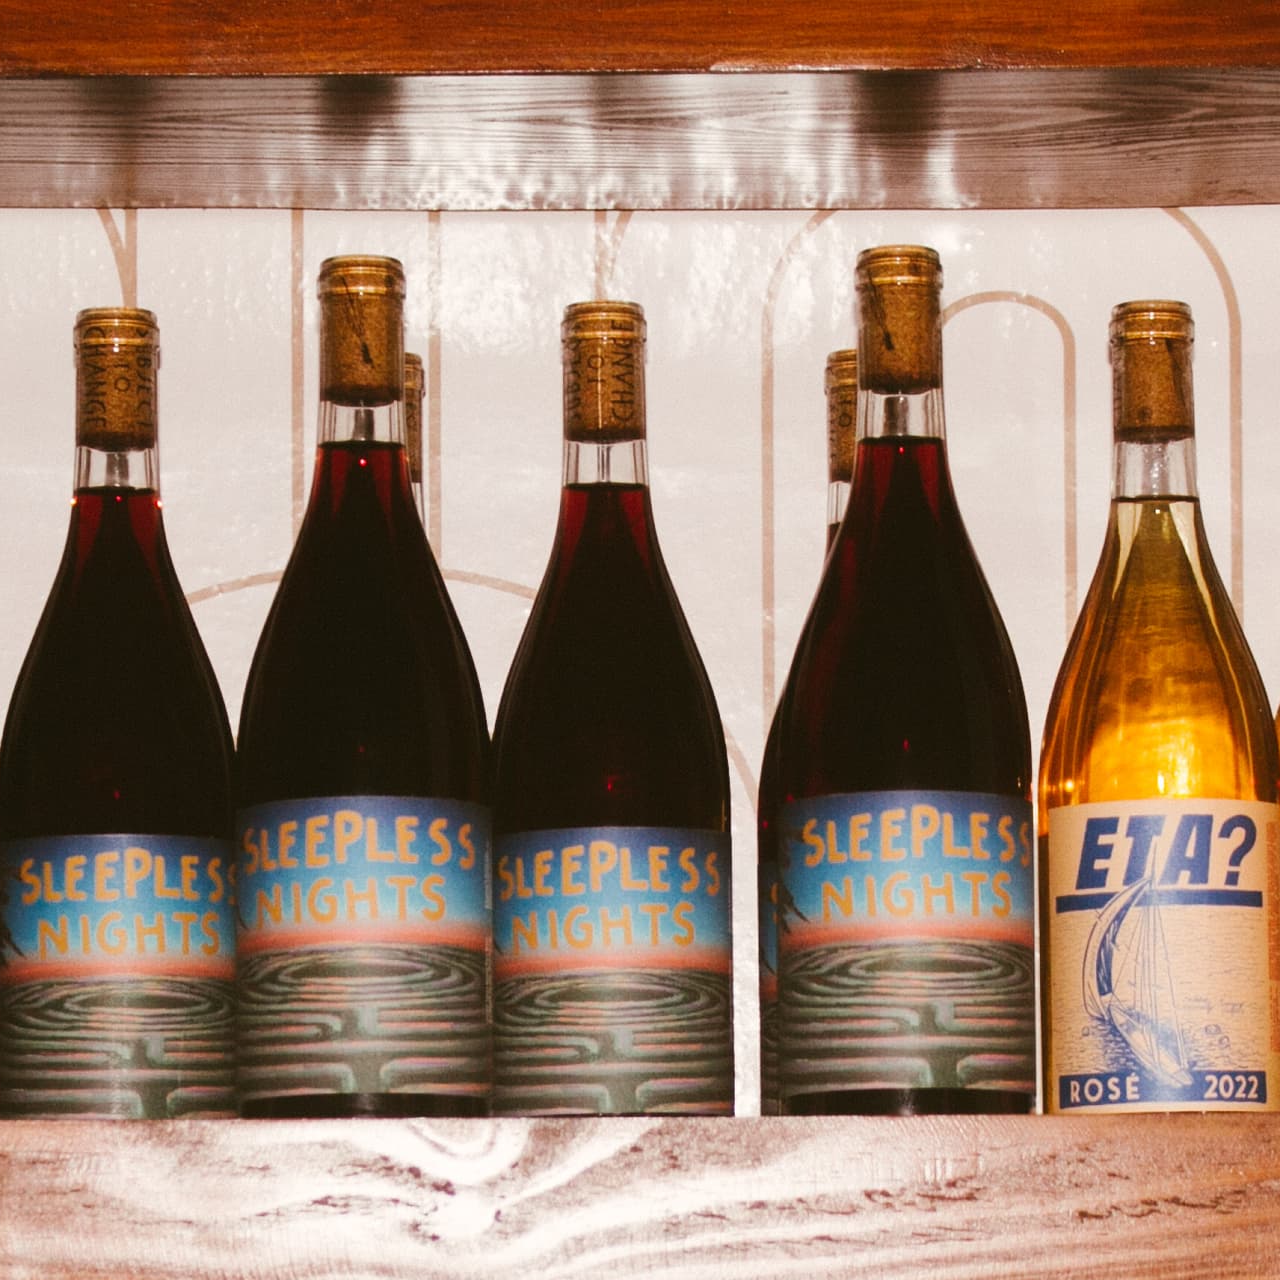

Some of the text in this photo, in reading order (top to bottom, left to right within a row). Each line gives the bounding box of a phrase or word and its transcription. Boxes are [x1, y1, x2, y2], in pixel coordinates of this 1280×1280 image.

[243, 810, 476, 874] SLEEPLESS
[801, 804, 1031, 868] SLEEPLESS
[1076, 814, 1258, 889] ETA?
[498, 840, 720, 901] SLEEPLESS
[821, 871, 1013, 923] NIGHTS
[255, 873, 447, 930] NIGHTS
[511, 900, 696, 957] NIGHTS
[38, 910, 221, 961] NIGHTS
[1070, 1072, 1260, 1104] ROSÉ 2022
